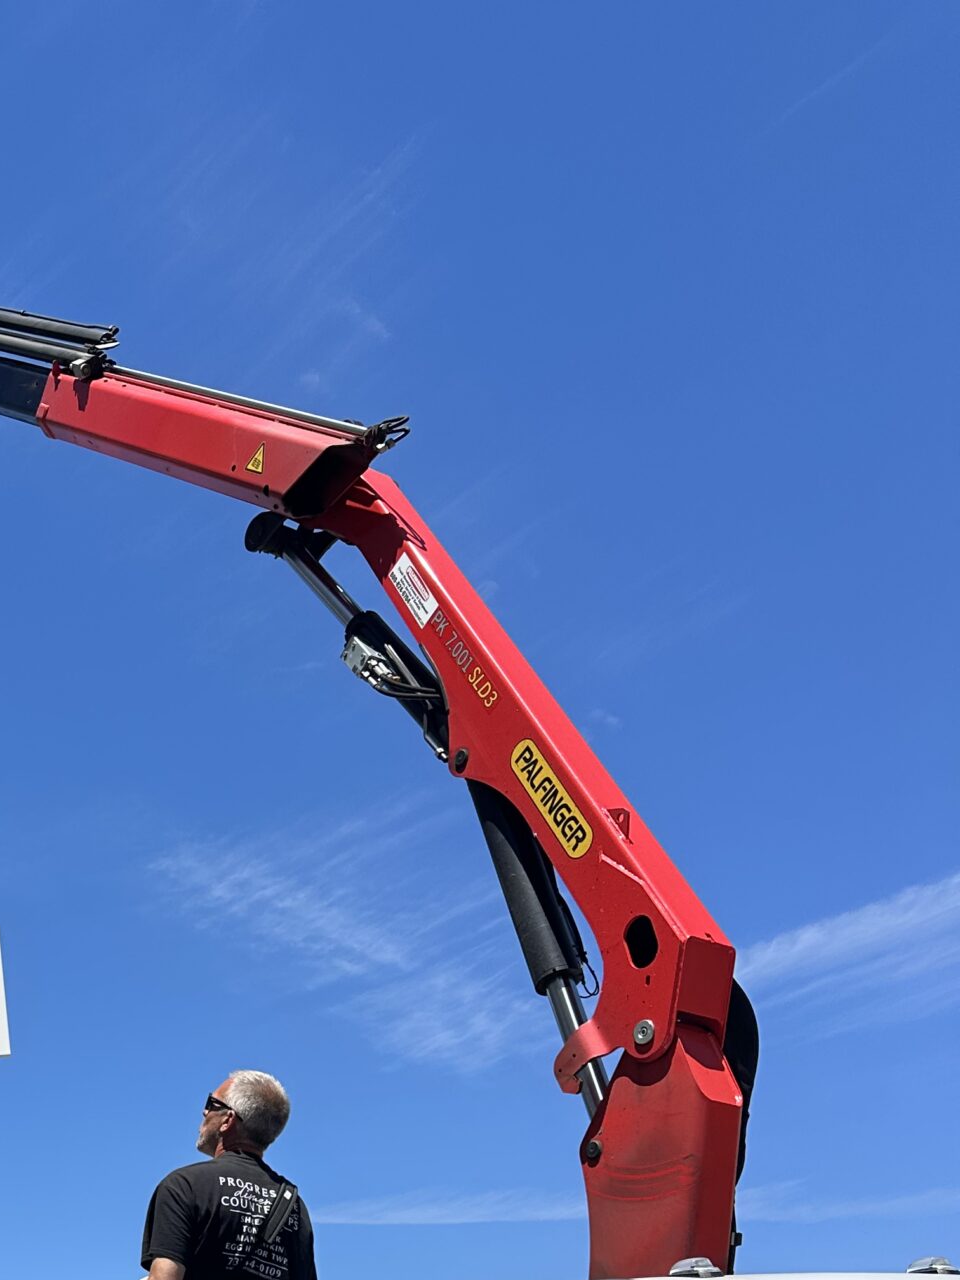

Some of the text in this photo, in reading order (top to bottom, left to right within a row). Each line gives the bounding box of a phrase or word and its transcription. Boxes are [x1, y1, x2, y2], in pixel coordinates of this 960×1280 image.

[431, 610, 498, 708] PK 7.001 SLD3
[515, 745, 587, 852] PALFINGER
